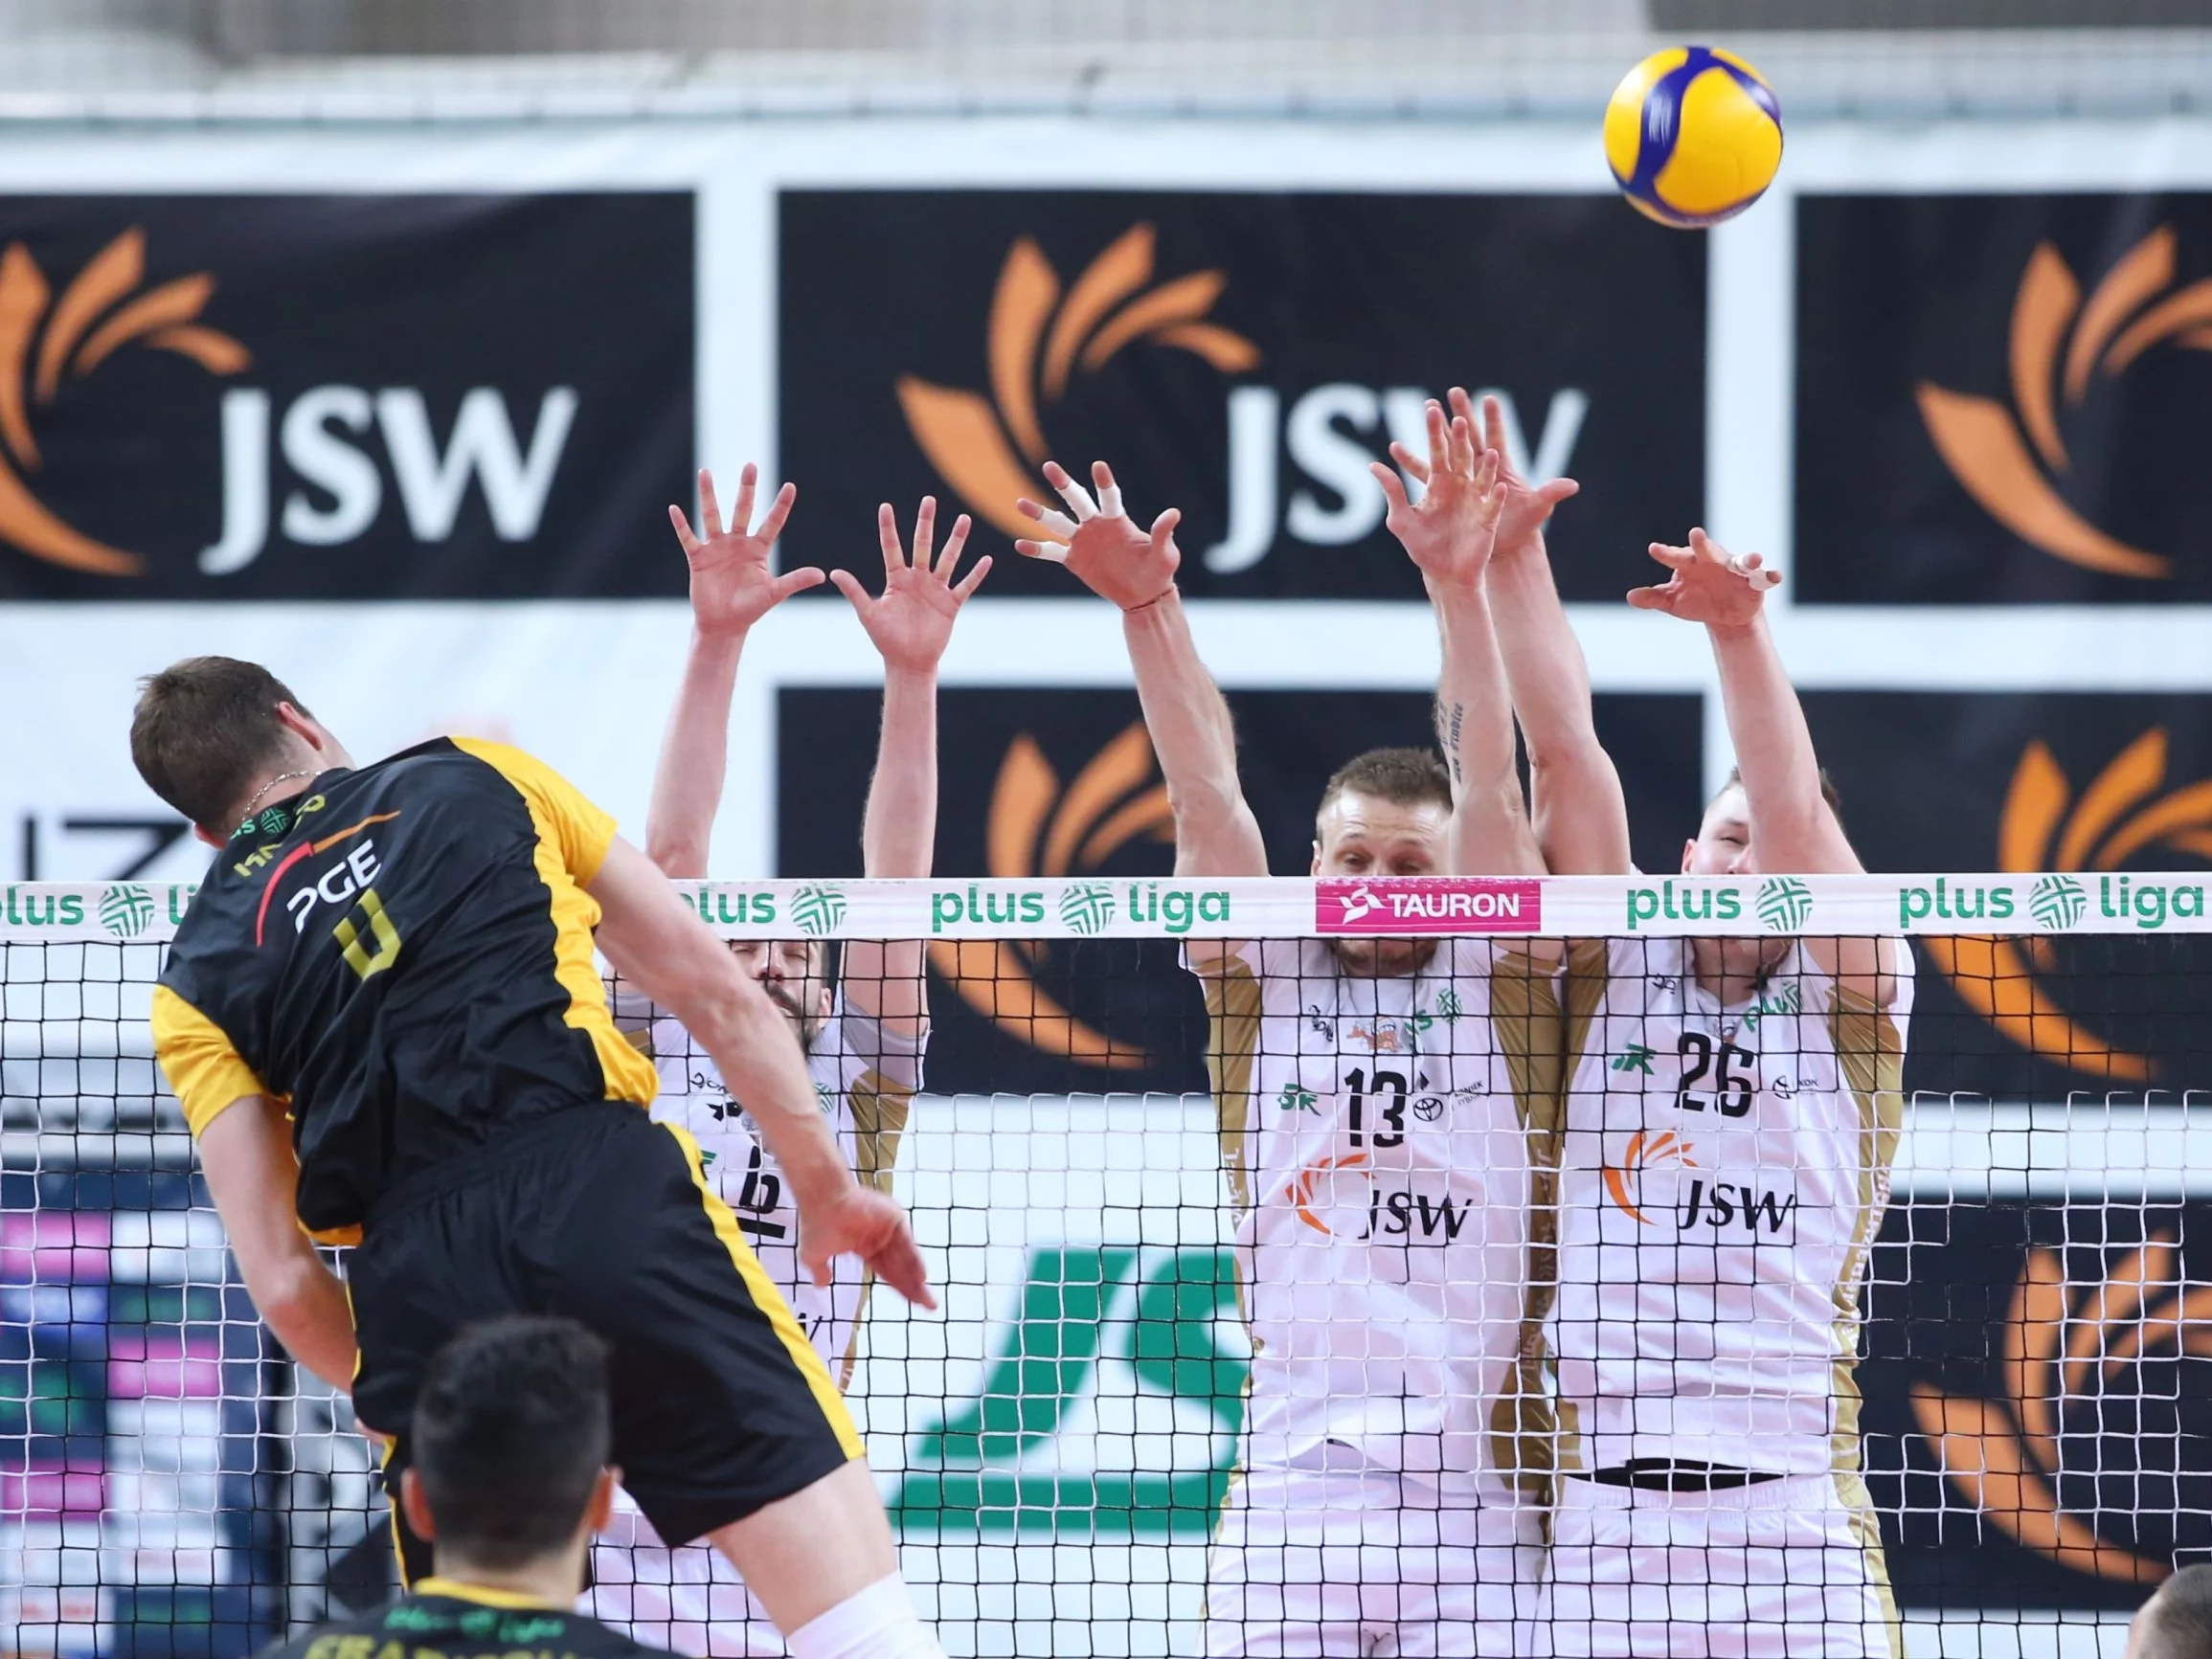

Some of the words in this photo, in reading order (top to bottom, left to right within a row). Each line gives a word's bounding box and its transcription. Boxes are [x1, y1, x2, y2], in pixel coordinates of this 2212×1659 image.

[197, 384, 578, 575] JSW
[0, 884, 84, 925] lus
[286, 839, 382, 934] PGE
[678, 883, 777, 924] lus
[932, 883, 1045, 932] plus
[1129, 882, 1231, 933] liga
[1388, 892, 1520, 918] TAURON
[1627, 880, 1742, 930] plus
[1900, 877, 2015, 929] plus
[2100, 876, 2204, 929] liga
[1674, 1031, 1755, 1118] 26
[1344, 1066, 1408, 1148] 13
[1358, 1189, 1473, 1240] JSW
[1678, 1179, 1794, 1233] JSW
